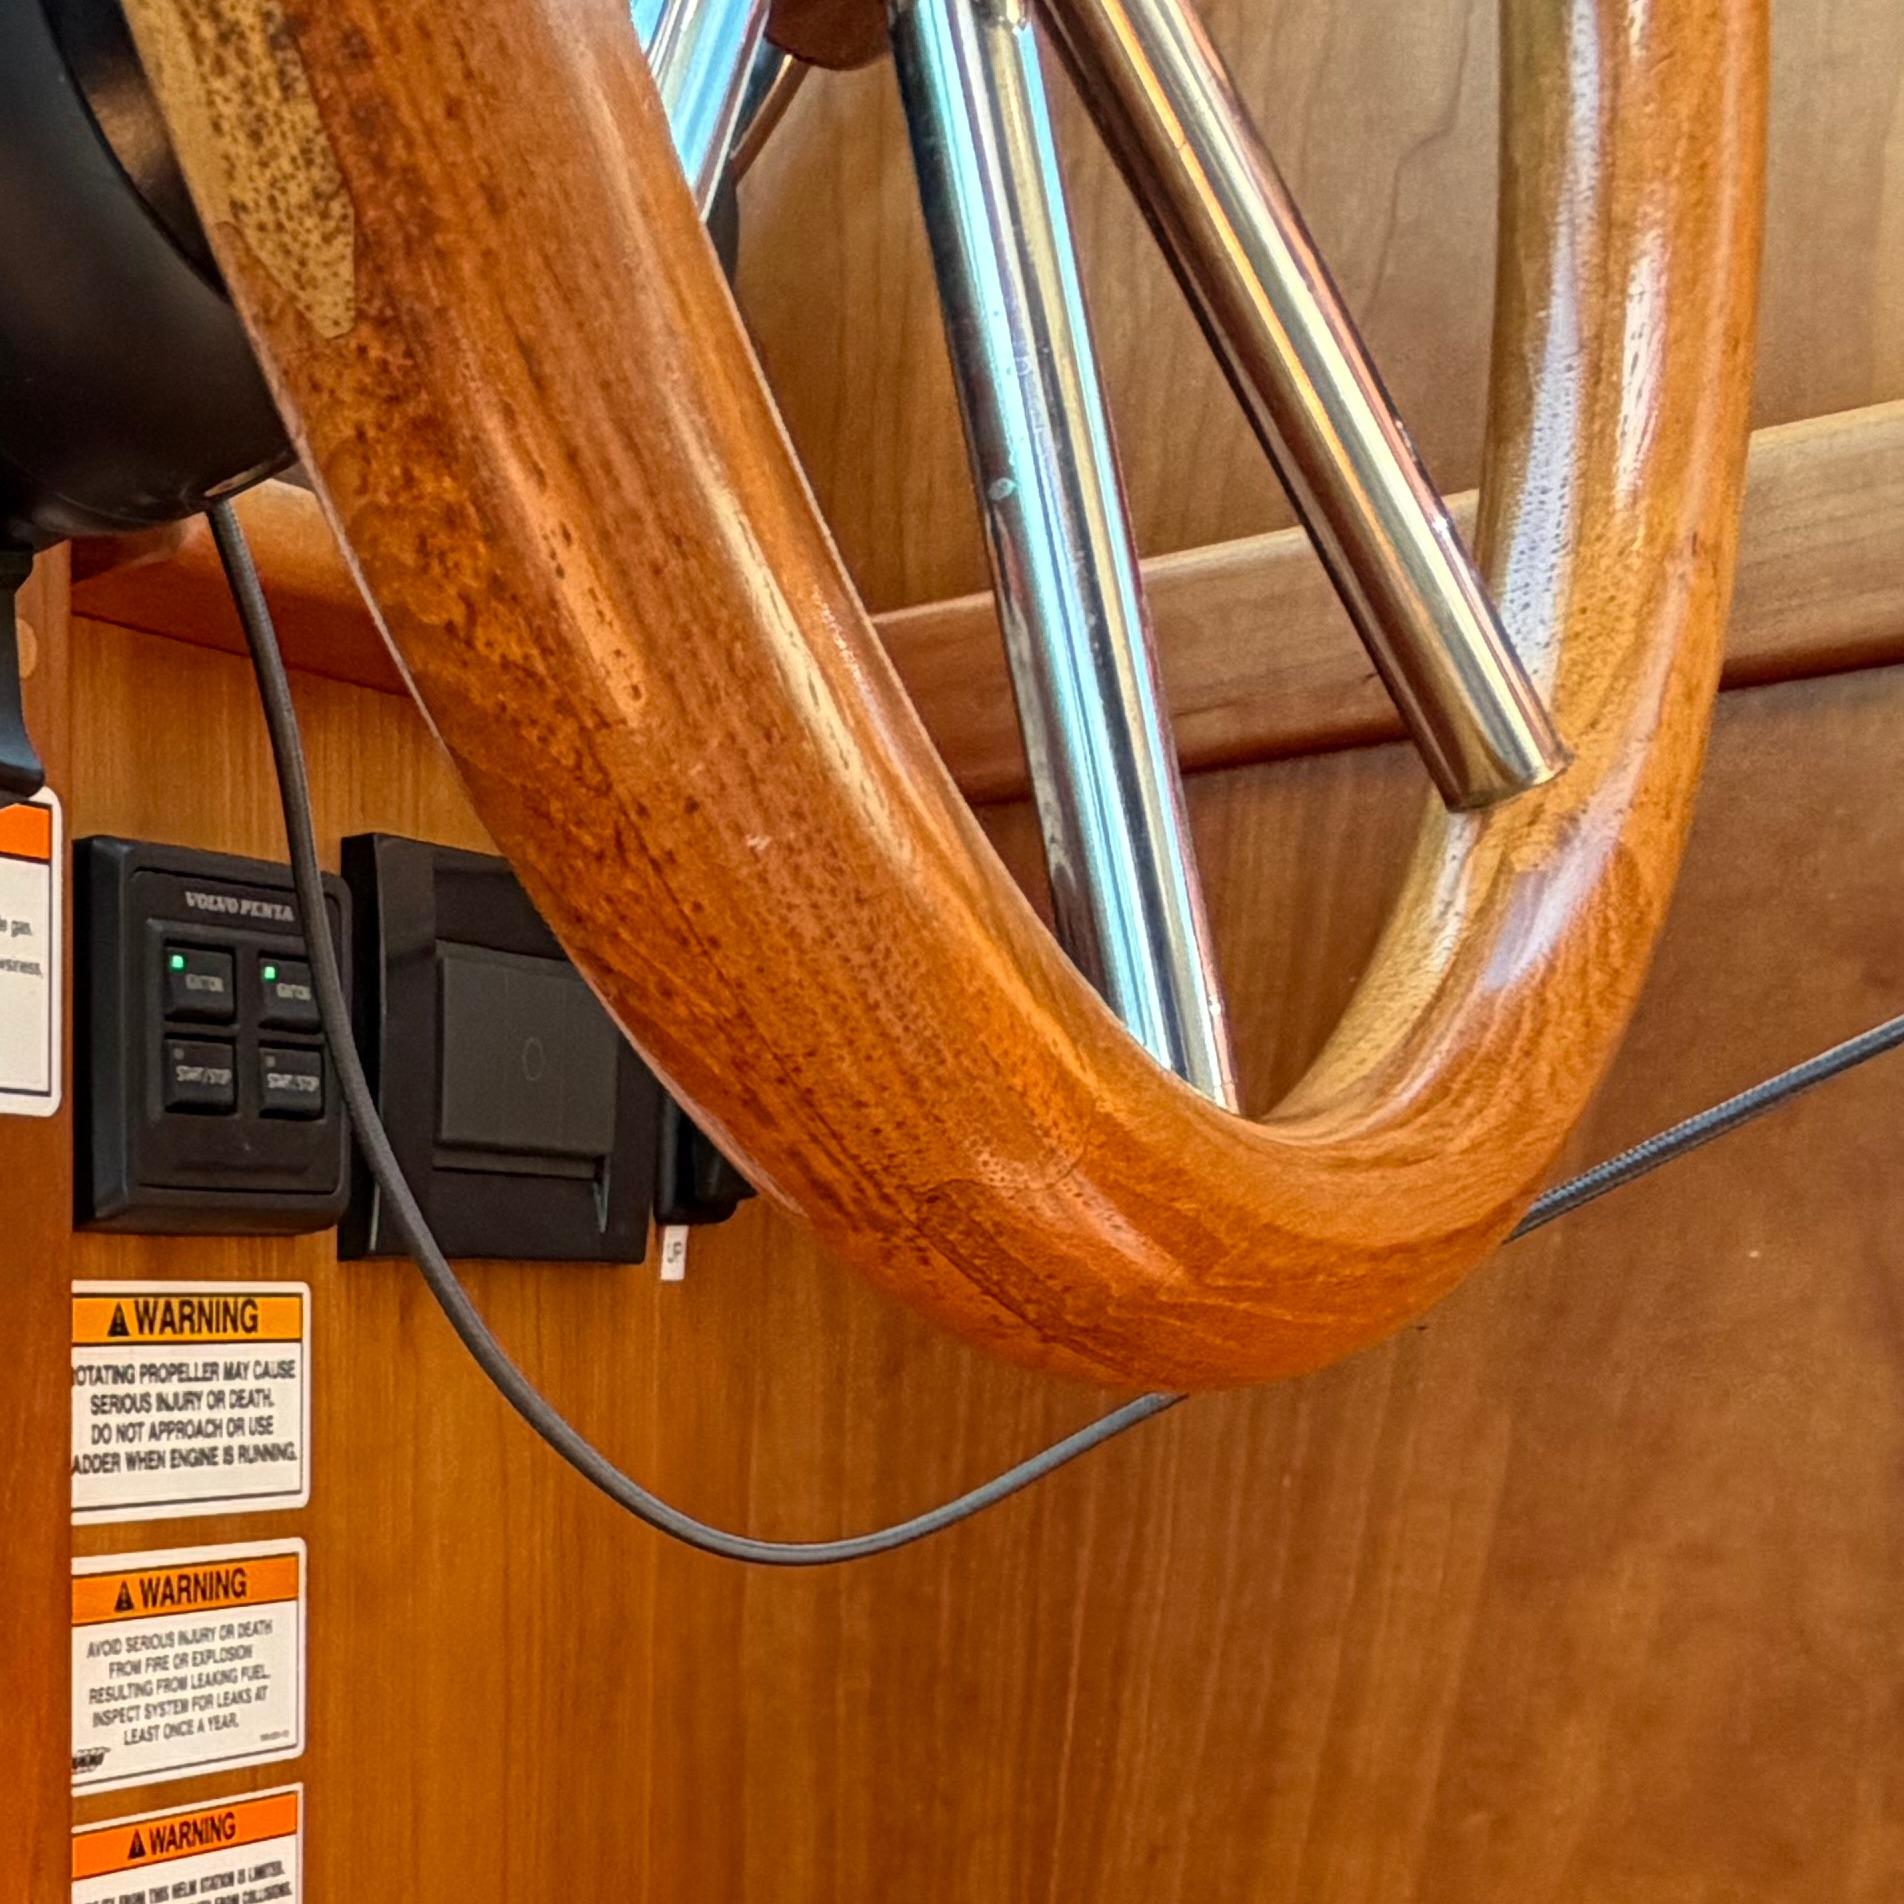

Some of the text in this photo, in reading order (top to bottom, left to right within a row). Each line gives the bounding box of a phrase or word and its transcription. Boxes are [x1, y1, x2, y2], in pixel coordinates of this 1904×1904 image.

[185, 891, 295, 922] VOLVO PENTA
[134, 1298, 259, 1336] WARNING
[72, 1359, 296, 1386] OTATING PROPELLER MAY CAUSE
[90, 1392, 152, 1416] SERIOUS
[156, 1390, 203, 1412] INJURY
[206, 1389, 225, 1408] OR
[91, 1415, 274, 1445] DO NOT APPROACH OR USE
[72, 1452, 121, 1475] ADDER
[126, 1449, 166, 1472] WHEN
[170, 1446, 219, 1469] ENGINE
[222, 1445, 235, 1465] IS
[139, 1567, 247, 1609] WARNING
[149, 1812, 236, 1856] WARNING
